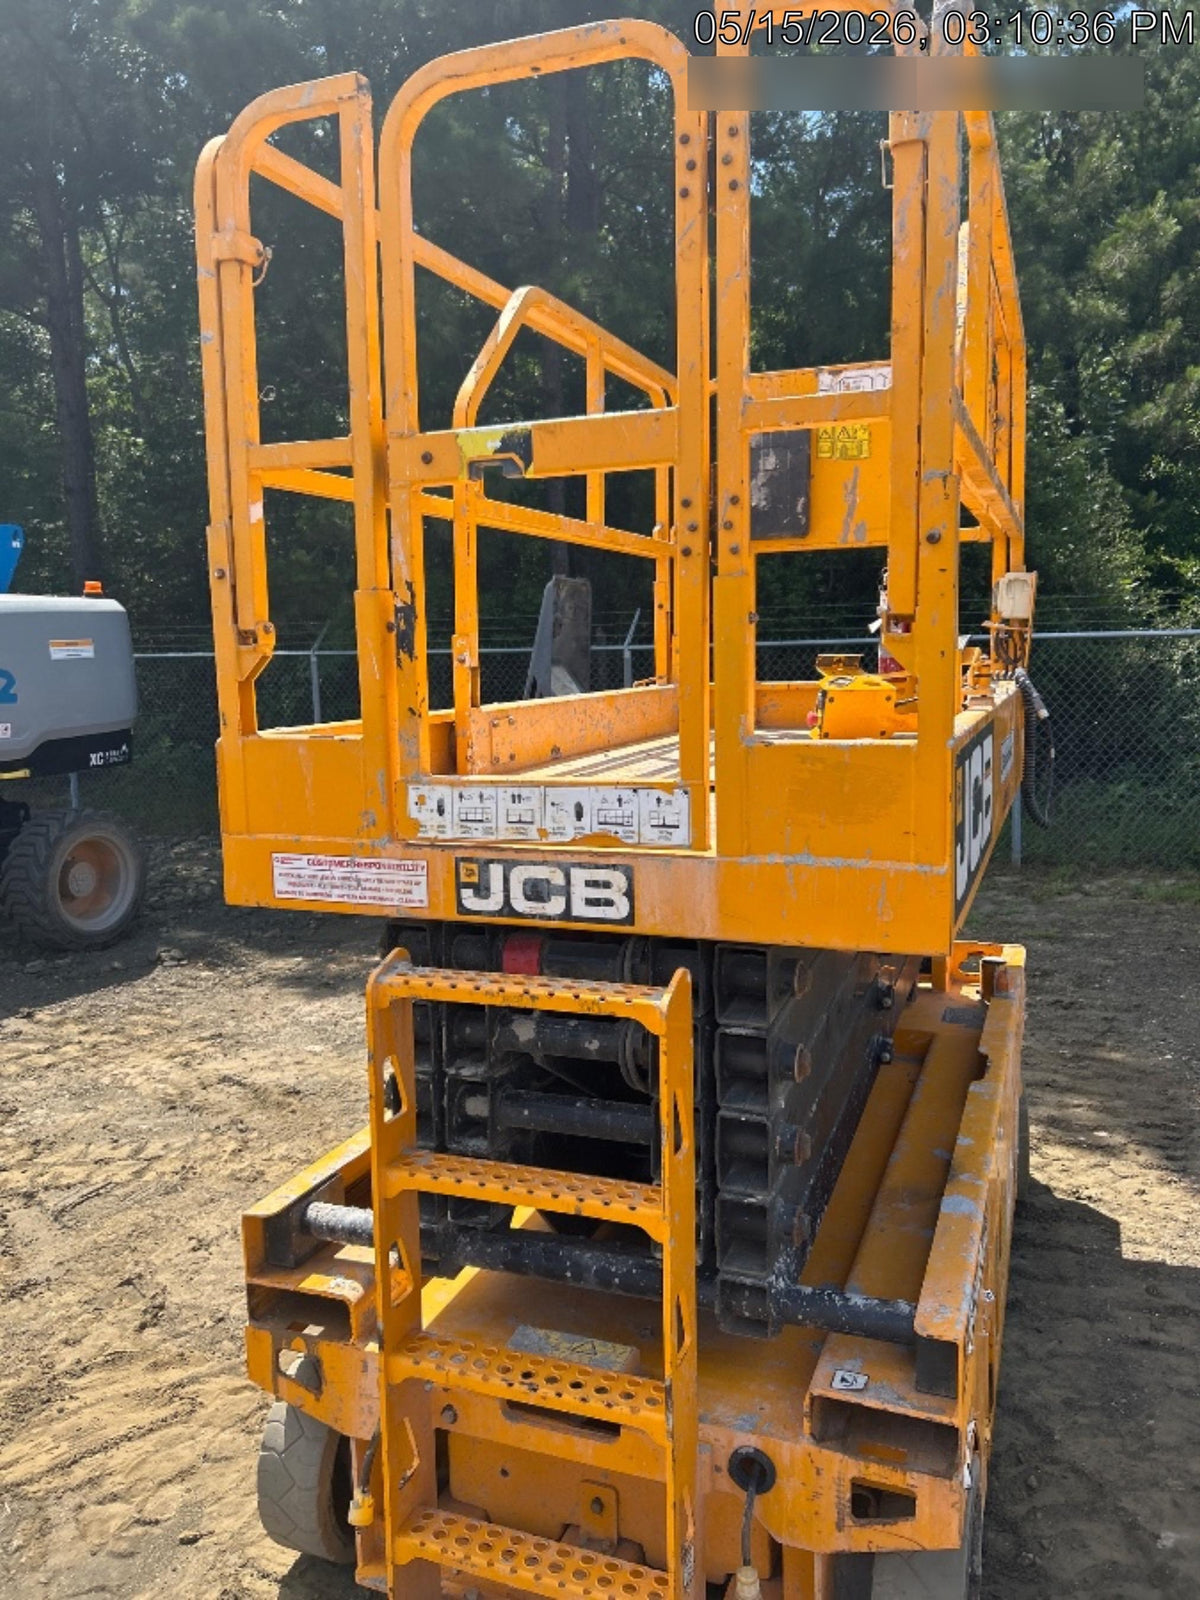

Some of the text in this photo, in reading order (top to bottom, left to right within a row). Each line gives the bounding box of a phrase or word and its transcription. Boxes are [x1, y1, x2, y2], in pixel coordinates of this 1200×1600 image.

[89, 751, 104, 767] XC
[956, 733, 993, 901] JCB
[459, 863, 631, 920] JCB
